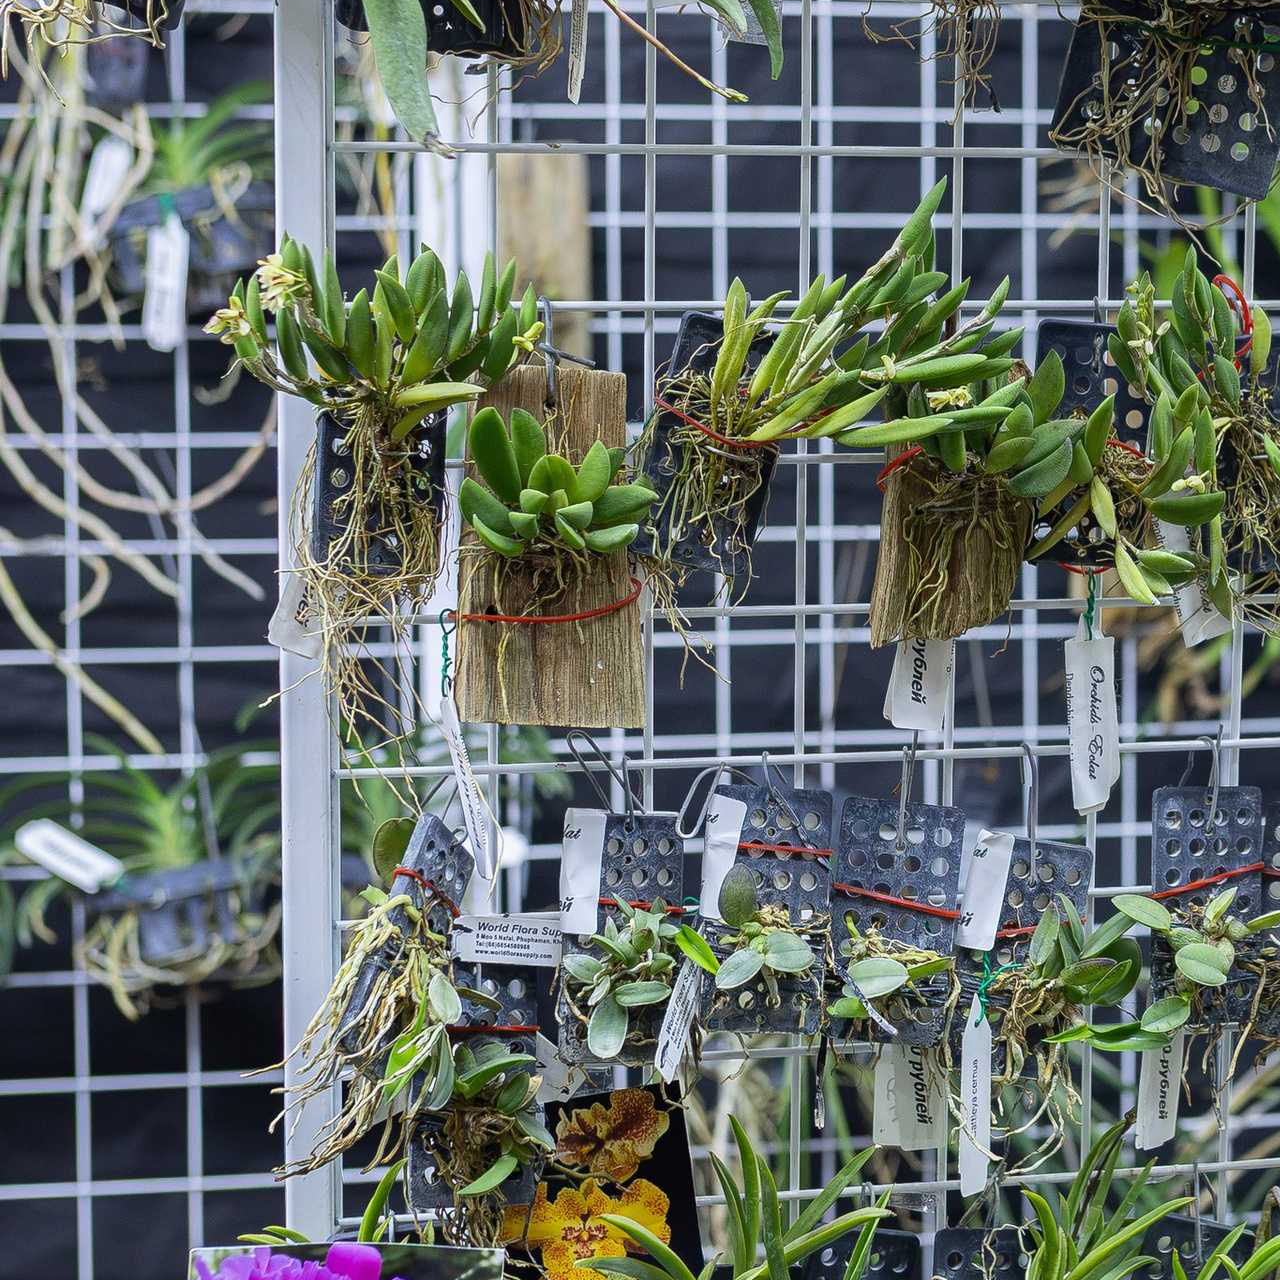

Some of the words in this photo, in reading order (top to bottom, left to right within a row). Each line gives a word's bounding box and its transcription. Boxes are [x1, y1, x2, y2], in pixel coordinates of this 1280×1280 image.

[477, 921, 509, 933] World
[511, 924, 539, 935] Flora
[541, 927, 562, 938] Sup
[475, 949, 553, 959] www.worldflorasupply.com
[665, 1005, 677, 1034] World
[674, 984, 686, 1007] Flora
[908, 1058, 933, 1125] рублей
[970, 1059, 979, 1094] cernua
[1158, 1058, 1170, 1120] рублей
